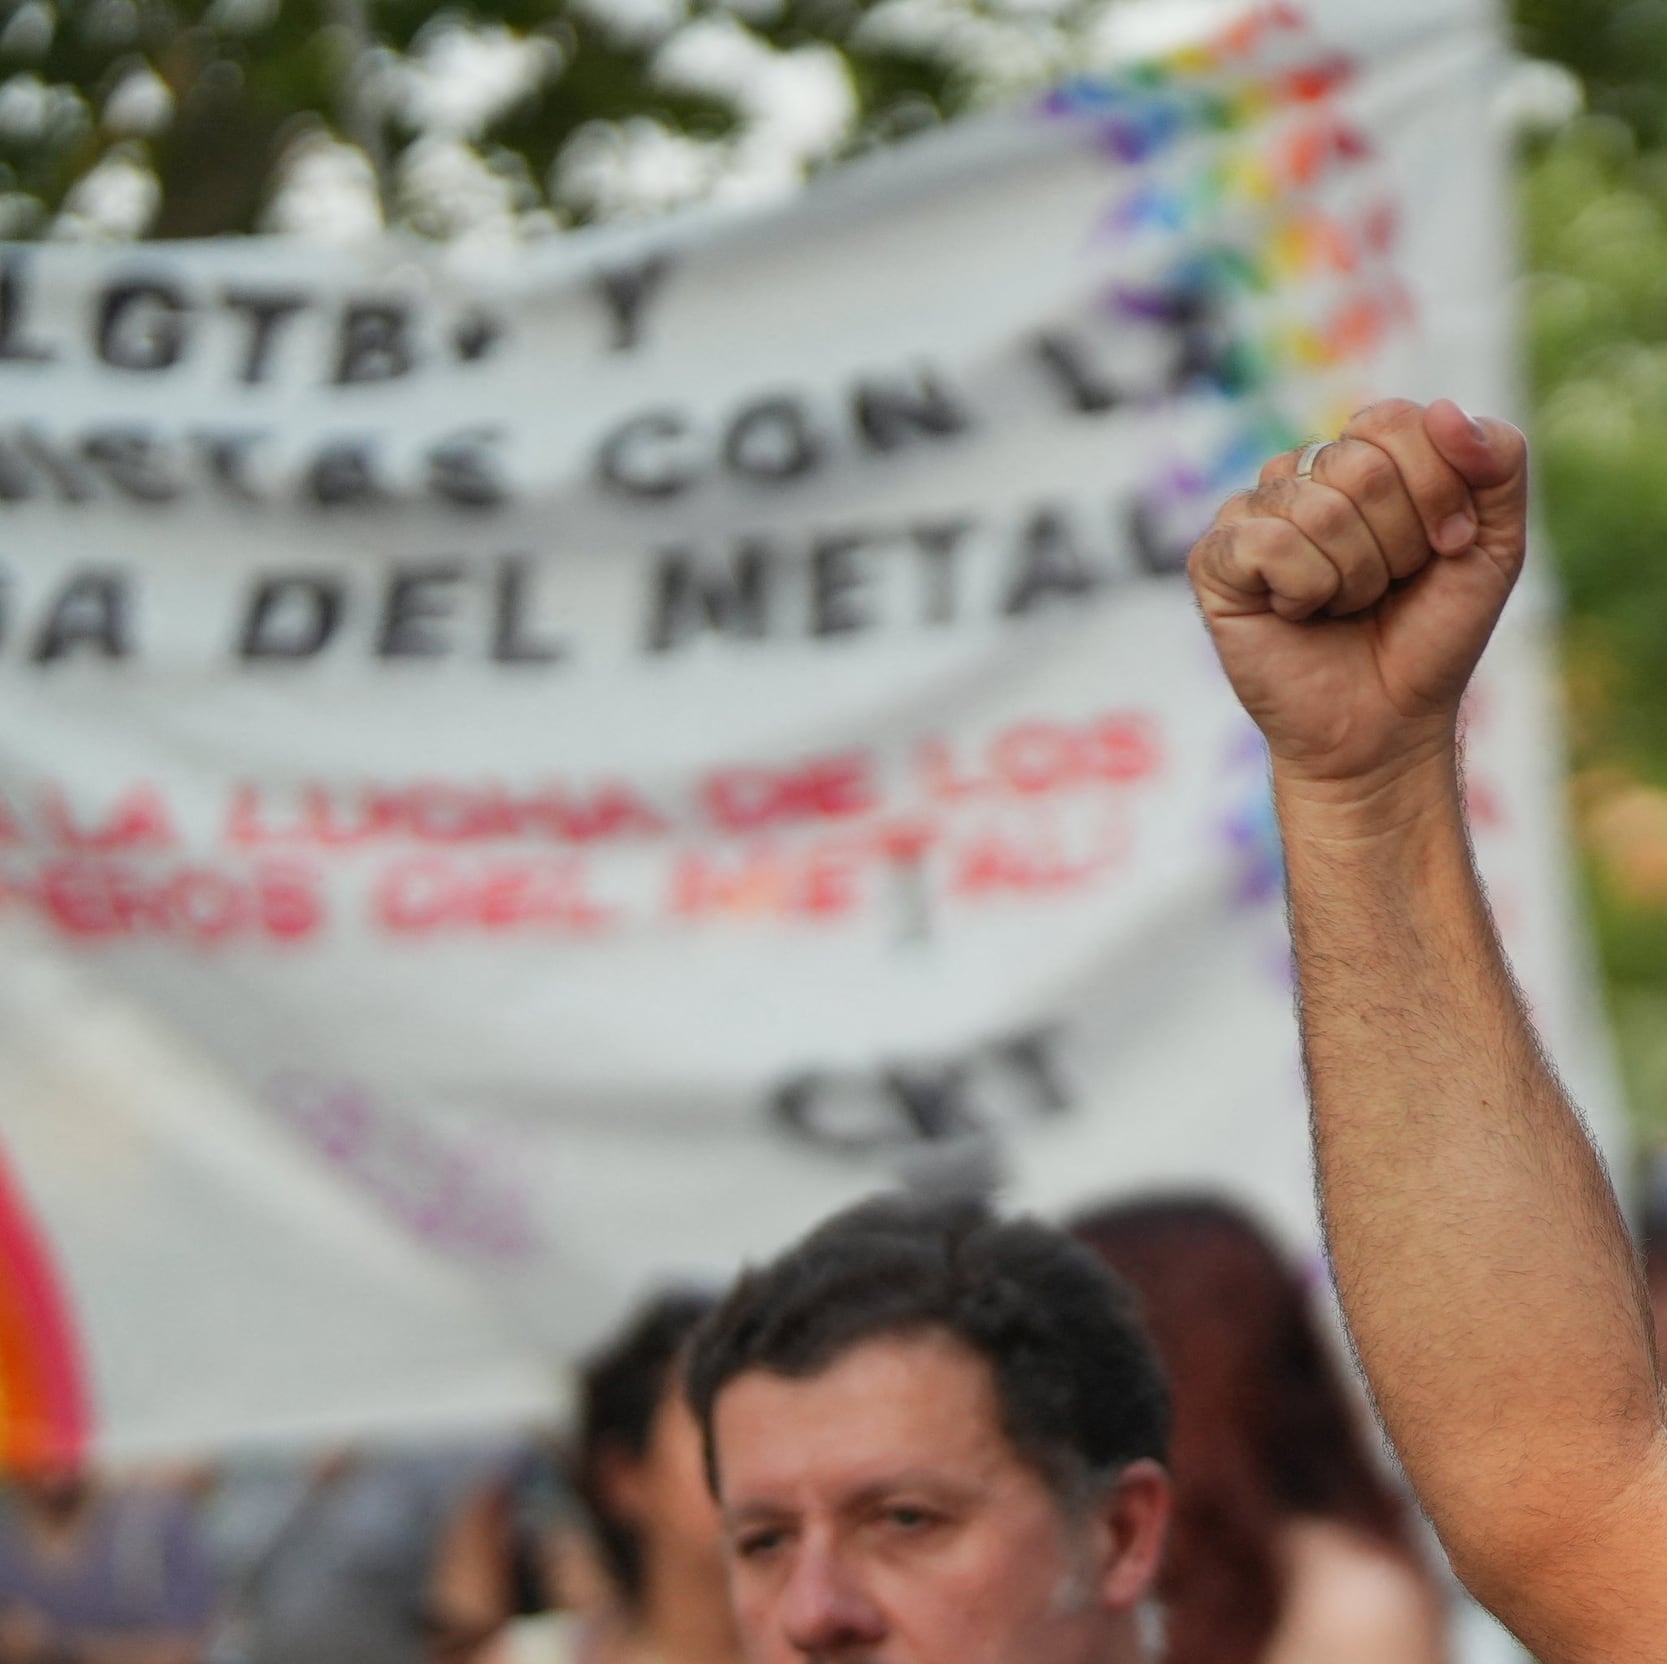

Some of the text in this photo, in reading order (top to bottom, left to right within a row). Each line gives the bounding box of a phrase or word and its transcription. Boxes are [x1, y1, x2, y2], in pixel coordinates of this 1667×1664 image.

[592, 258, 674, 352] Y
[596, 367, 968, 500] CON
[236, 557, 560, 666] DEL
[645, 495, 1188, 655] METAL
[698, 750, 882, 832] DE
[918, 711, 1164, 800] LOS
[370, 853, 615, 942] DEL
